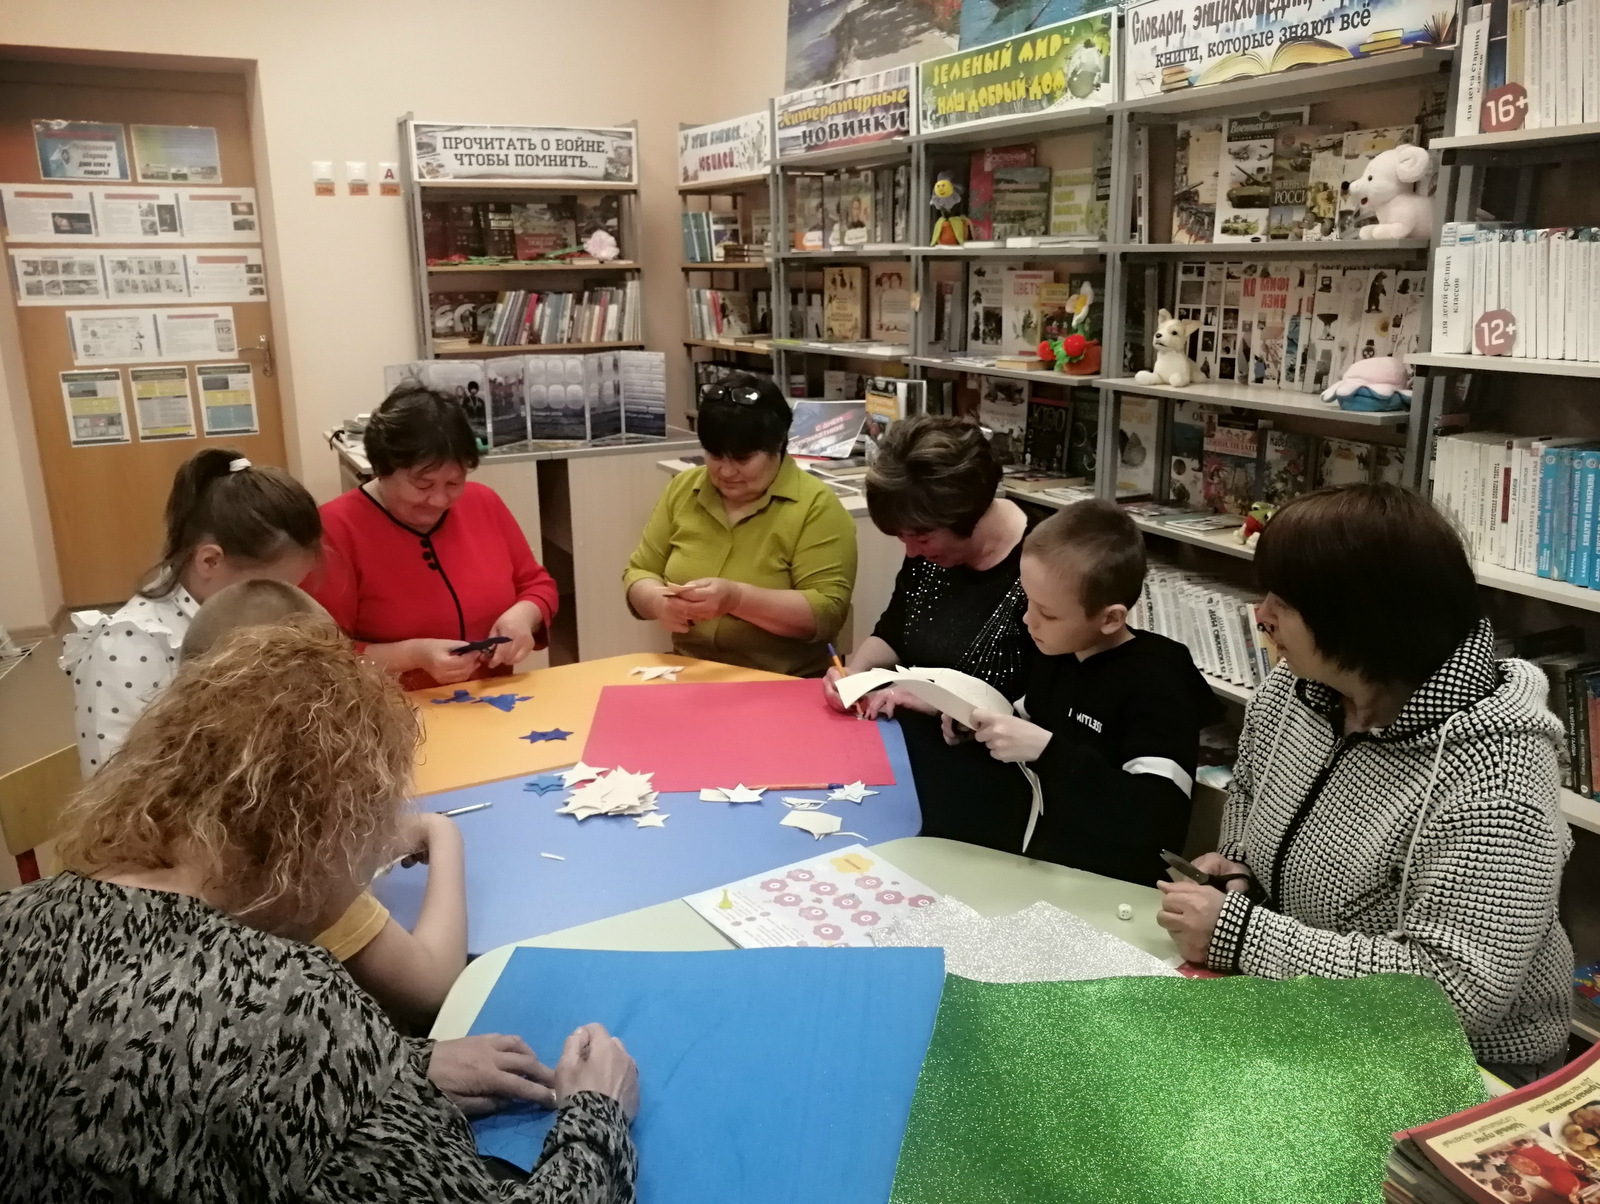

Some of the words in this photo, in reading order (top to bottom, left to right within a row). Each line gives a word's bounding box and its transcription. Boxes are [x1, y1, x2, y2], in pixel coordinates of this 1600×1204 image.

[1131, 10, 1187, 47] Словари,
[1155, 45, 1203, 69] книги,
[1207, 33, 1274, 61] которые
[1278, 17, 1334, 45] знают
[1338, 2, 1372, 31] всё
[932, 41, 1014, 87] ЗЕЛЕНЫЙ
[779, 88, 909, 129] Литературные
[937, 91, 966, 116] НАШ
[967, 72, 1027, 114] ДОБРЫЙ
[1029, 68, 1067, 101] ДОМ
[1229, 119, 1263, 135] Военная
[1486, 94, 1528, 126] 16+
[441, 136, 537, 151] ПРОЧИТАТЬ
[541, 138, 551, 151] О
[555, 137, 609, 155] ВОЙНЕ,
[800, 110, 909, 147] НОВИНКИ
[453, 153, 510, 167] ЧТОБЫ
[515, 154, 598, 169] ПОМНИТЬ...
[1444, 255, 1452, 293] средних
[1261, 294, 1287, 309] АЗИИ
[216, 326, 232, 335] 112
[1480, 319, 1517, 347] 12+
